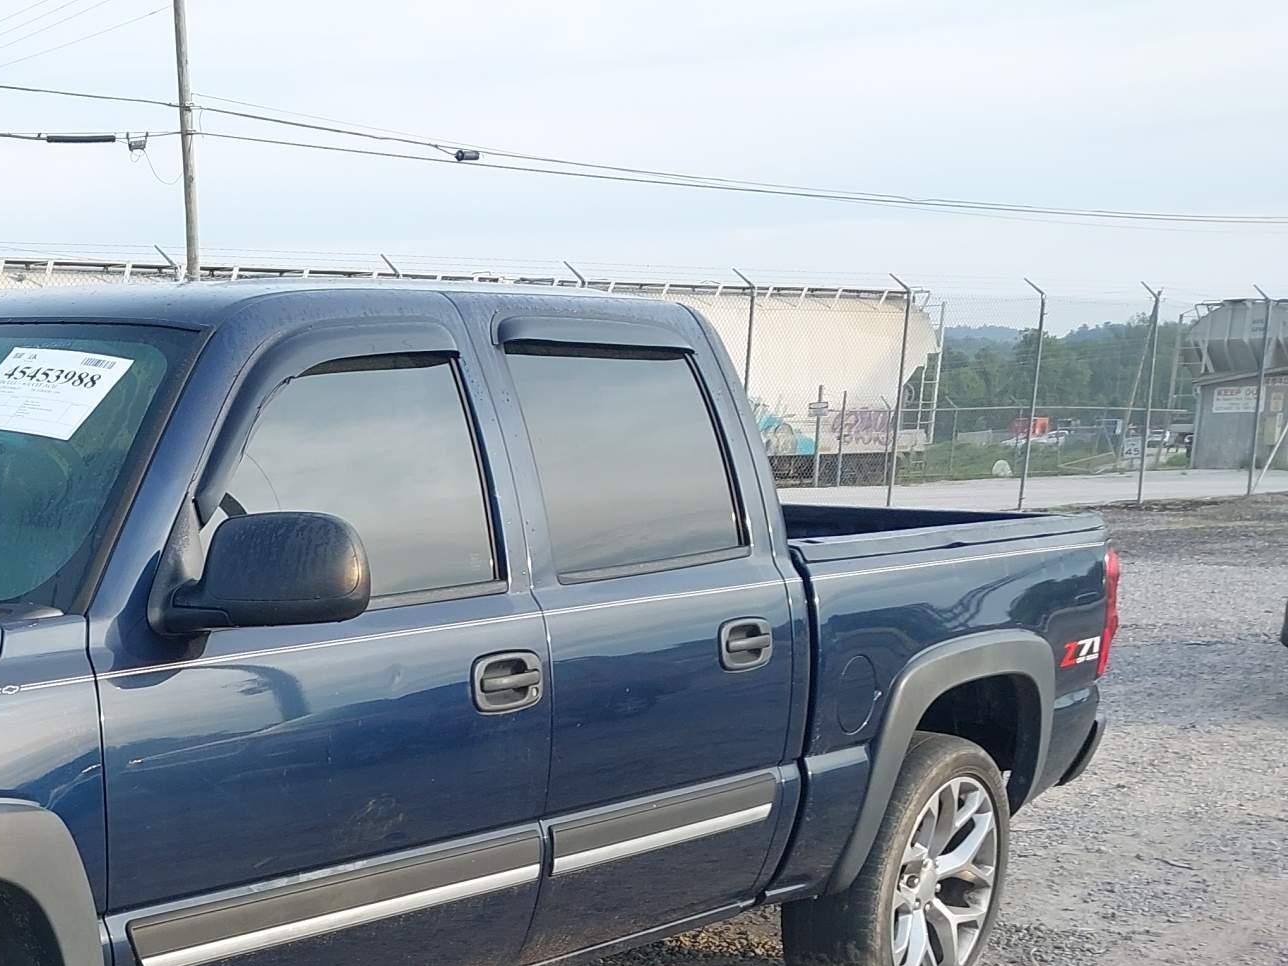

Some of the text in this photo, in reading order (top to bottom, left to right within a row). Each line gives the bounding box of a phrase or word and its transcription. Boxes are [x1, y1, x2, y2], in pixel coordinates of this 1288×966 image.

[4, 365, 102, 390] 45453988
[1125, 447, 1140, 456] 45
[1060, 636, 1100, 668] Z71
